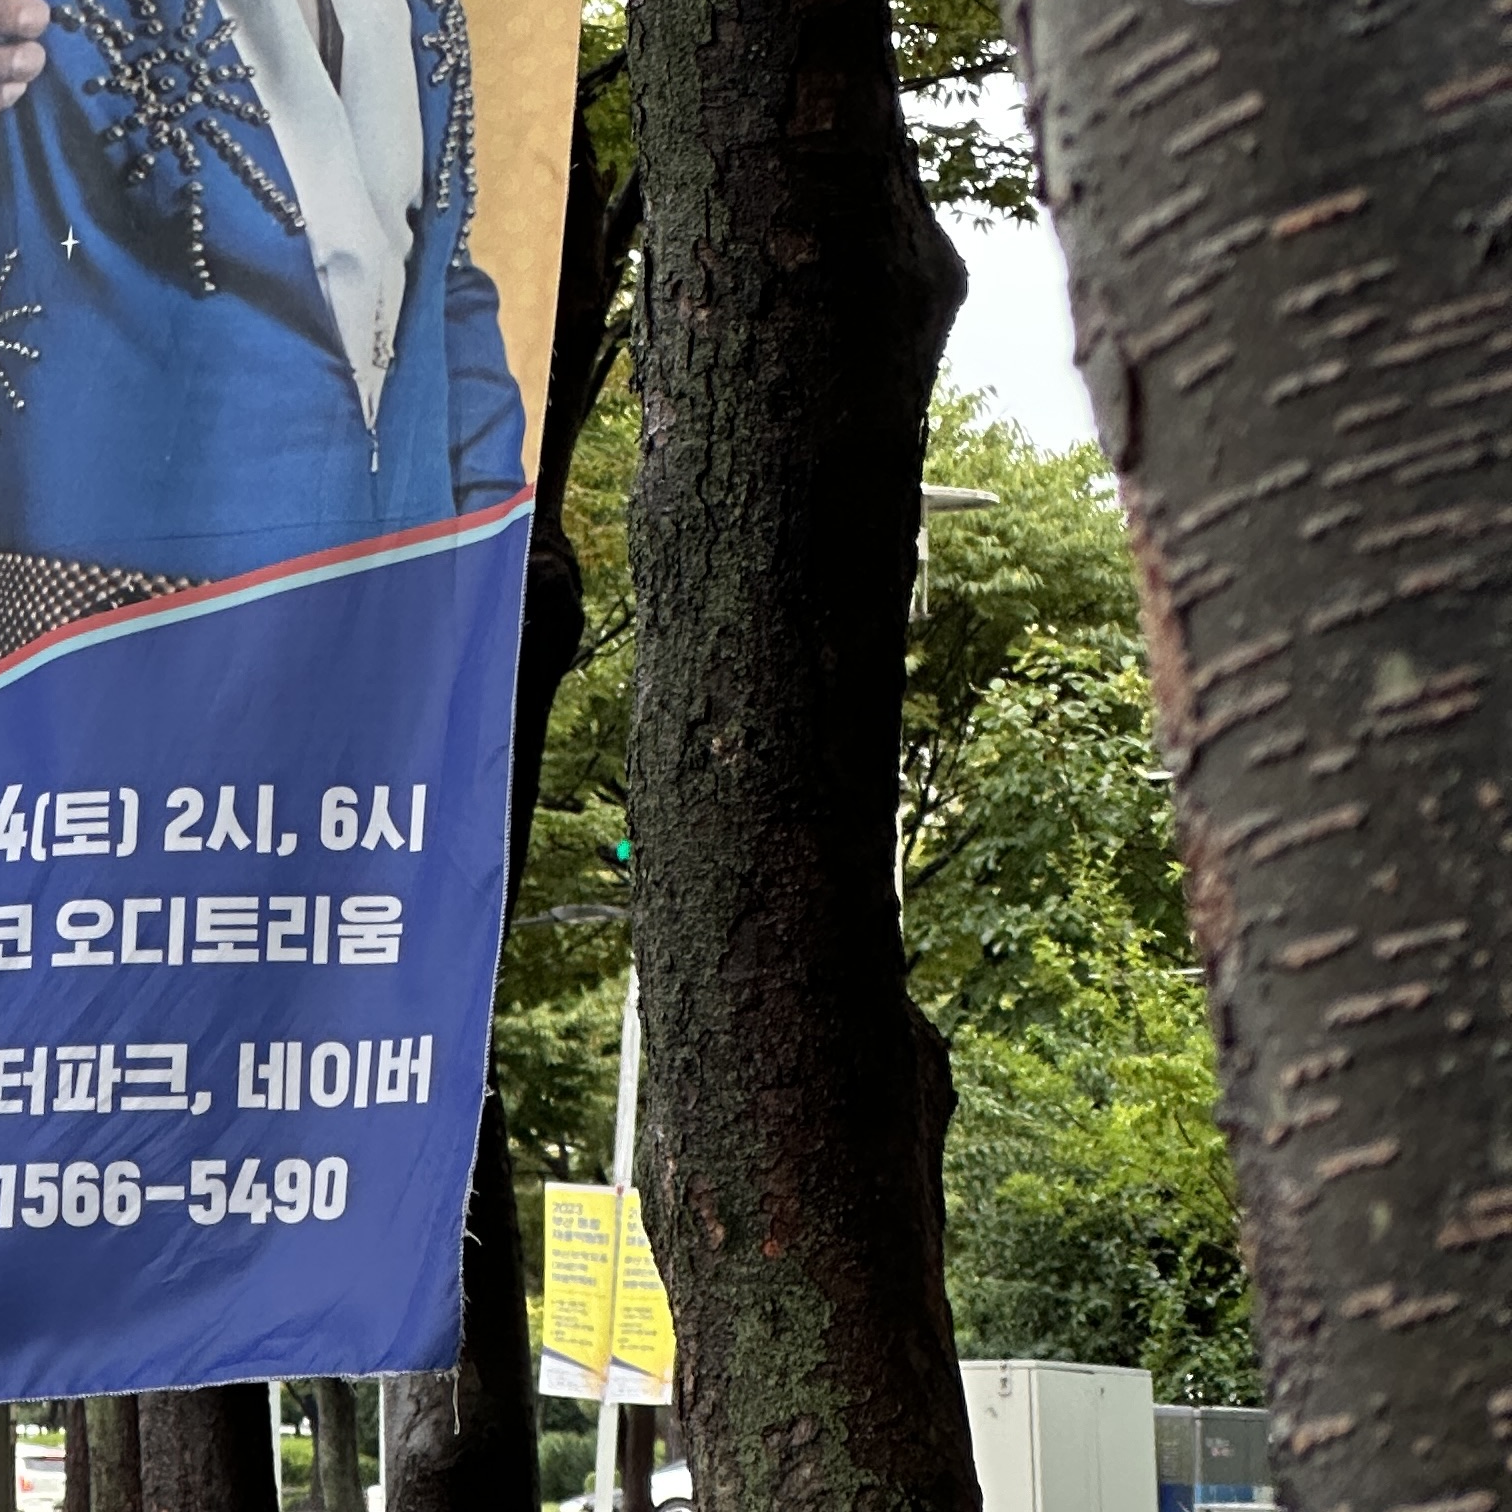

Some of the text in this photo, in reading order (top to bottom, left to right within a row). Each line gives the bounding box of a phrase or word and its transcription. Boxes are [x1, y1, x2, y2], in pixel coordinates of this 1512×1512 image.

[163, 784, 297, 857] 2시,
[319, 784, 427, 853] 6시
[50, 895, 404, 969] 오디토리움
[236, 1034, 434, 1111] 네이버
